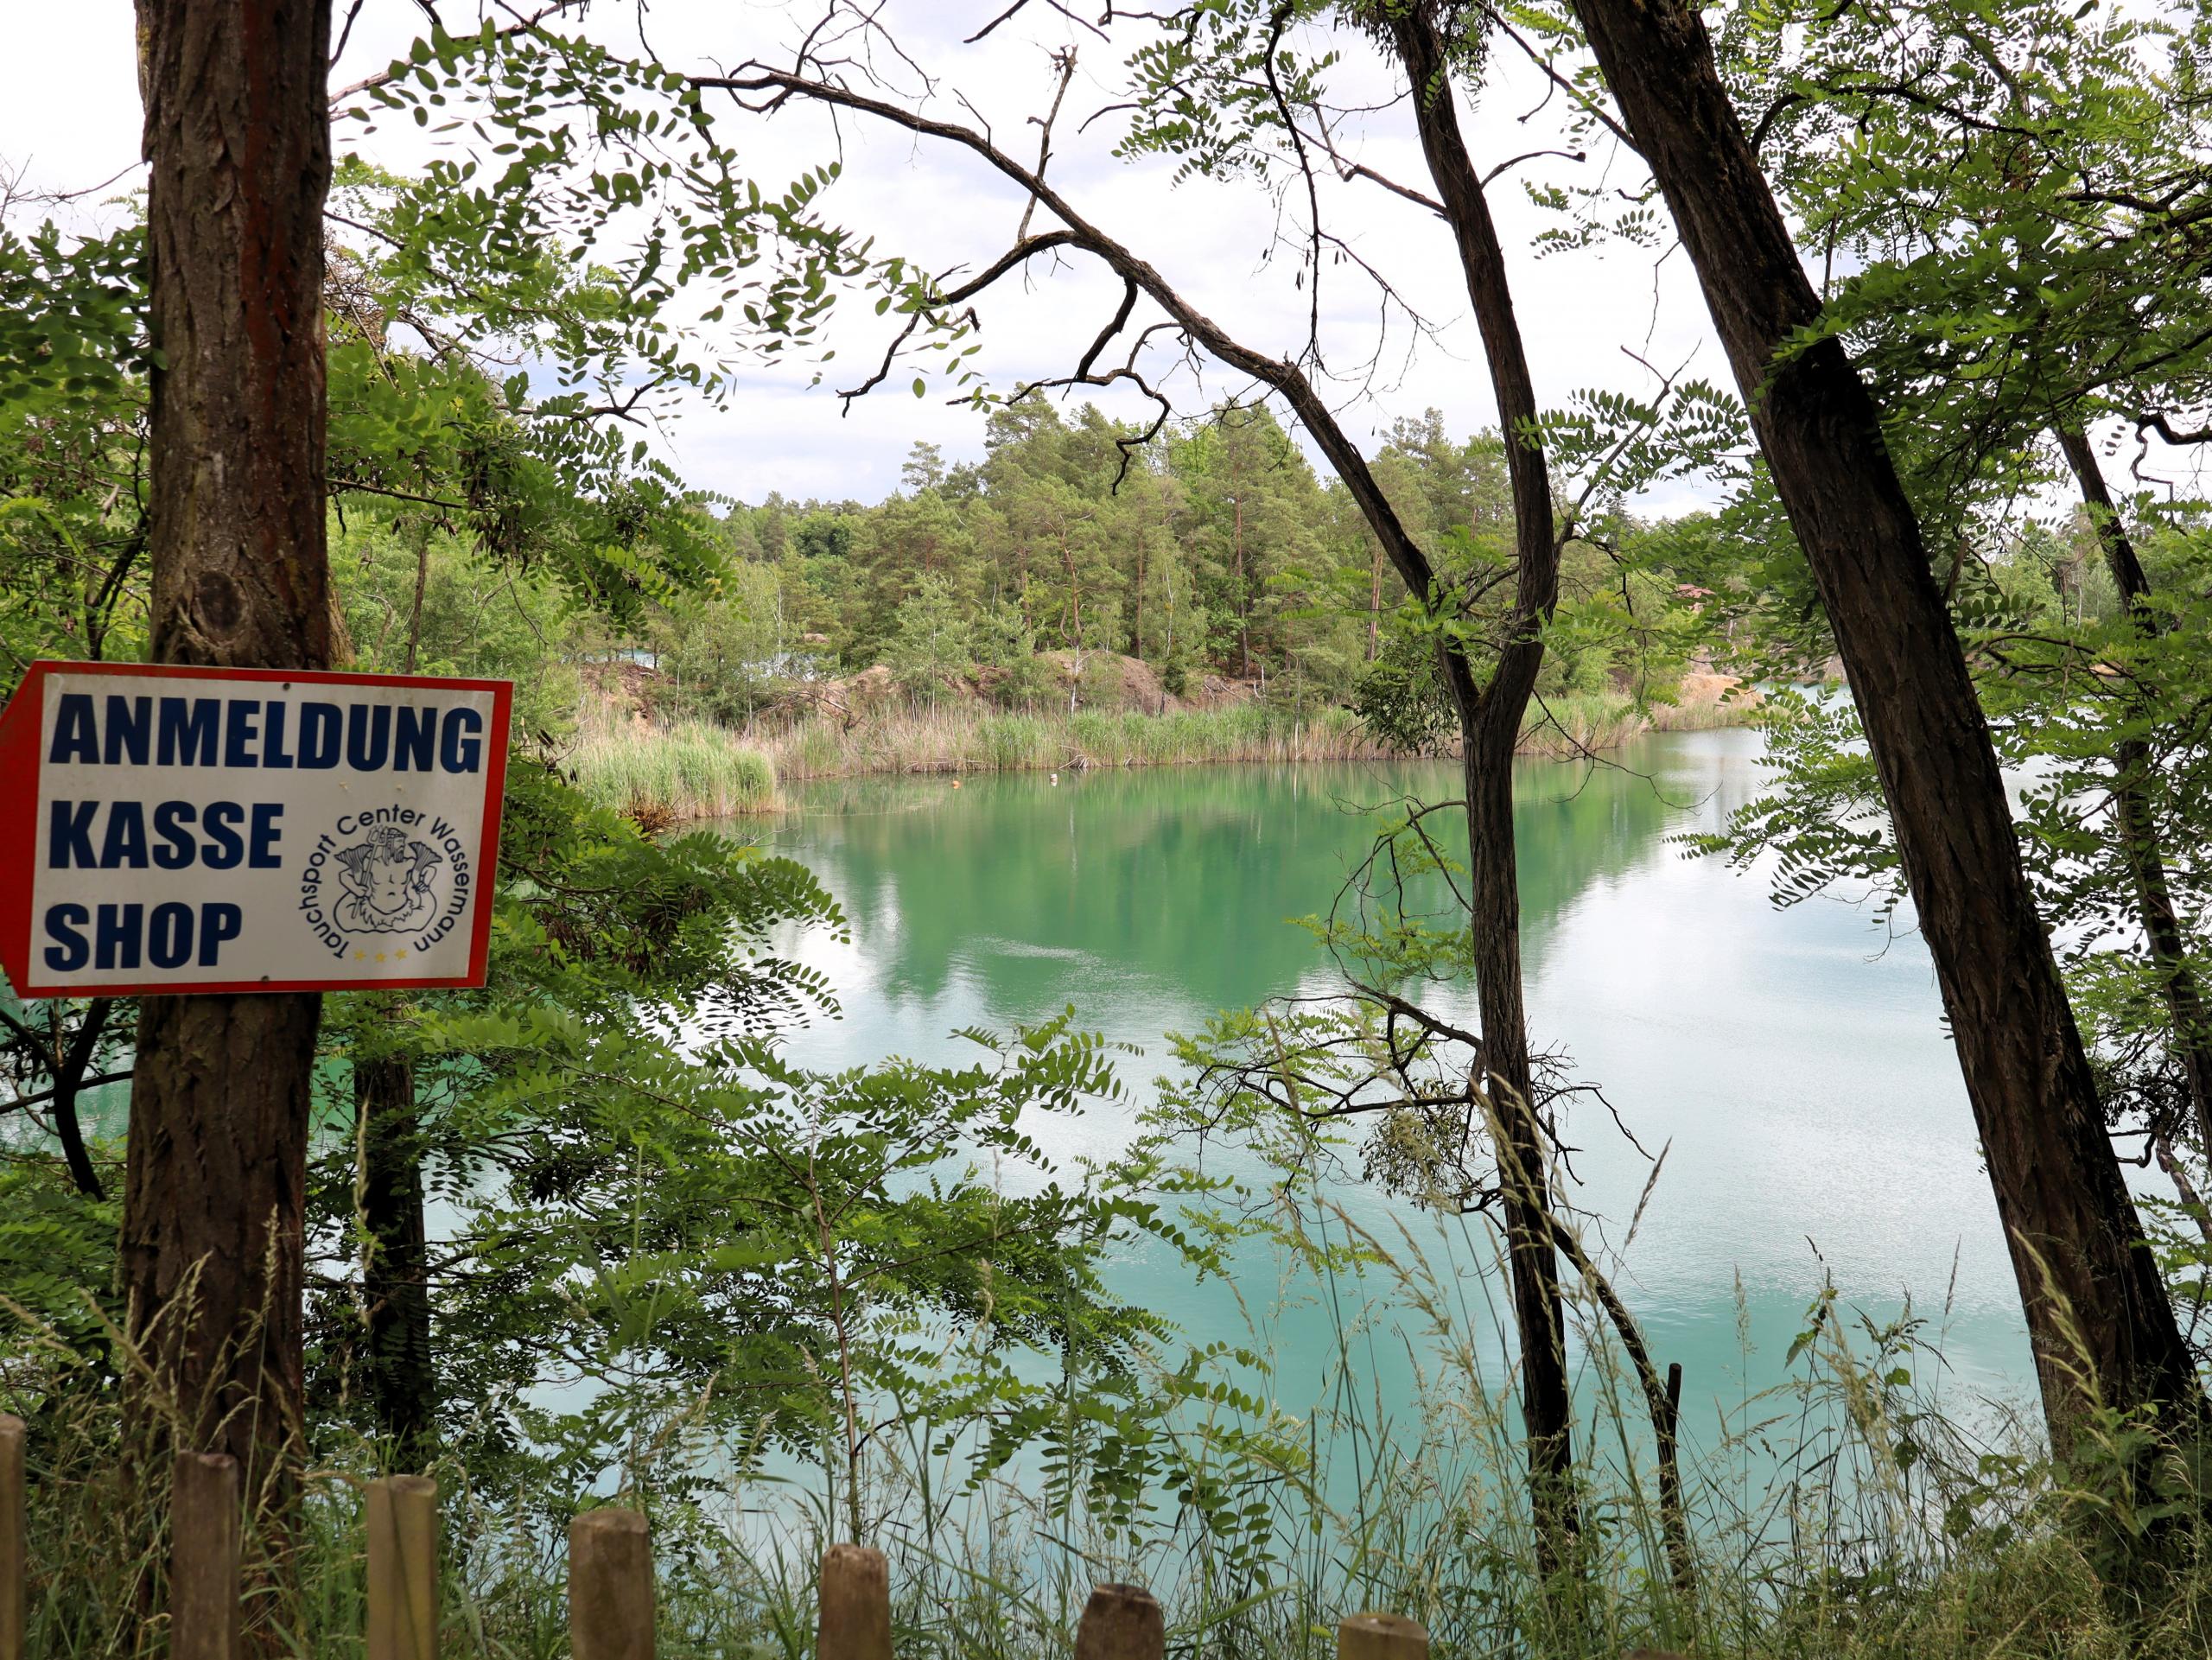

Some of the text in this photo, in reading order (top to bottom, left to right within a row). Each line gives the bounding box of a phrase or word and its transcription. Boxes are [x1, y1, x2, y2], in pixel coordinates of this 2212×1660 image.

[49, 693, 483, 773] ANMELDUNG
[49, 800, 284, 870] KASSE
[299, 804, 470, 958] Tauchsport Center Wassermann
[43, 902, 243, 971] SHOP
